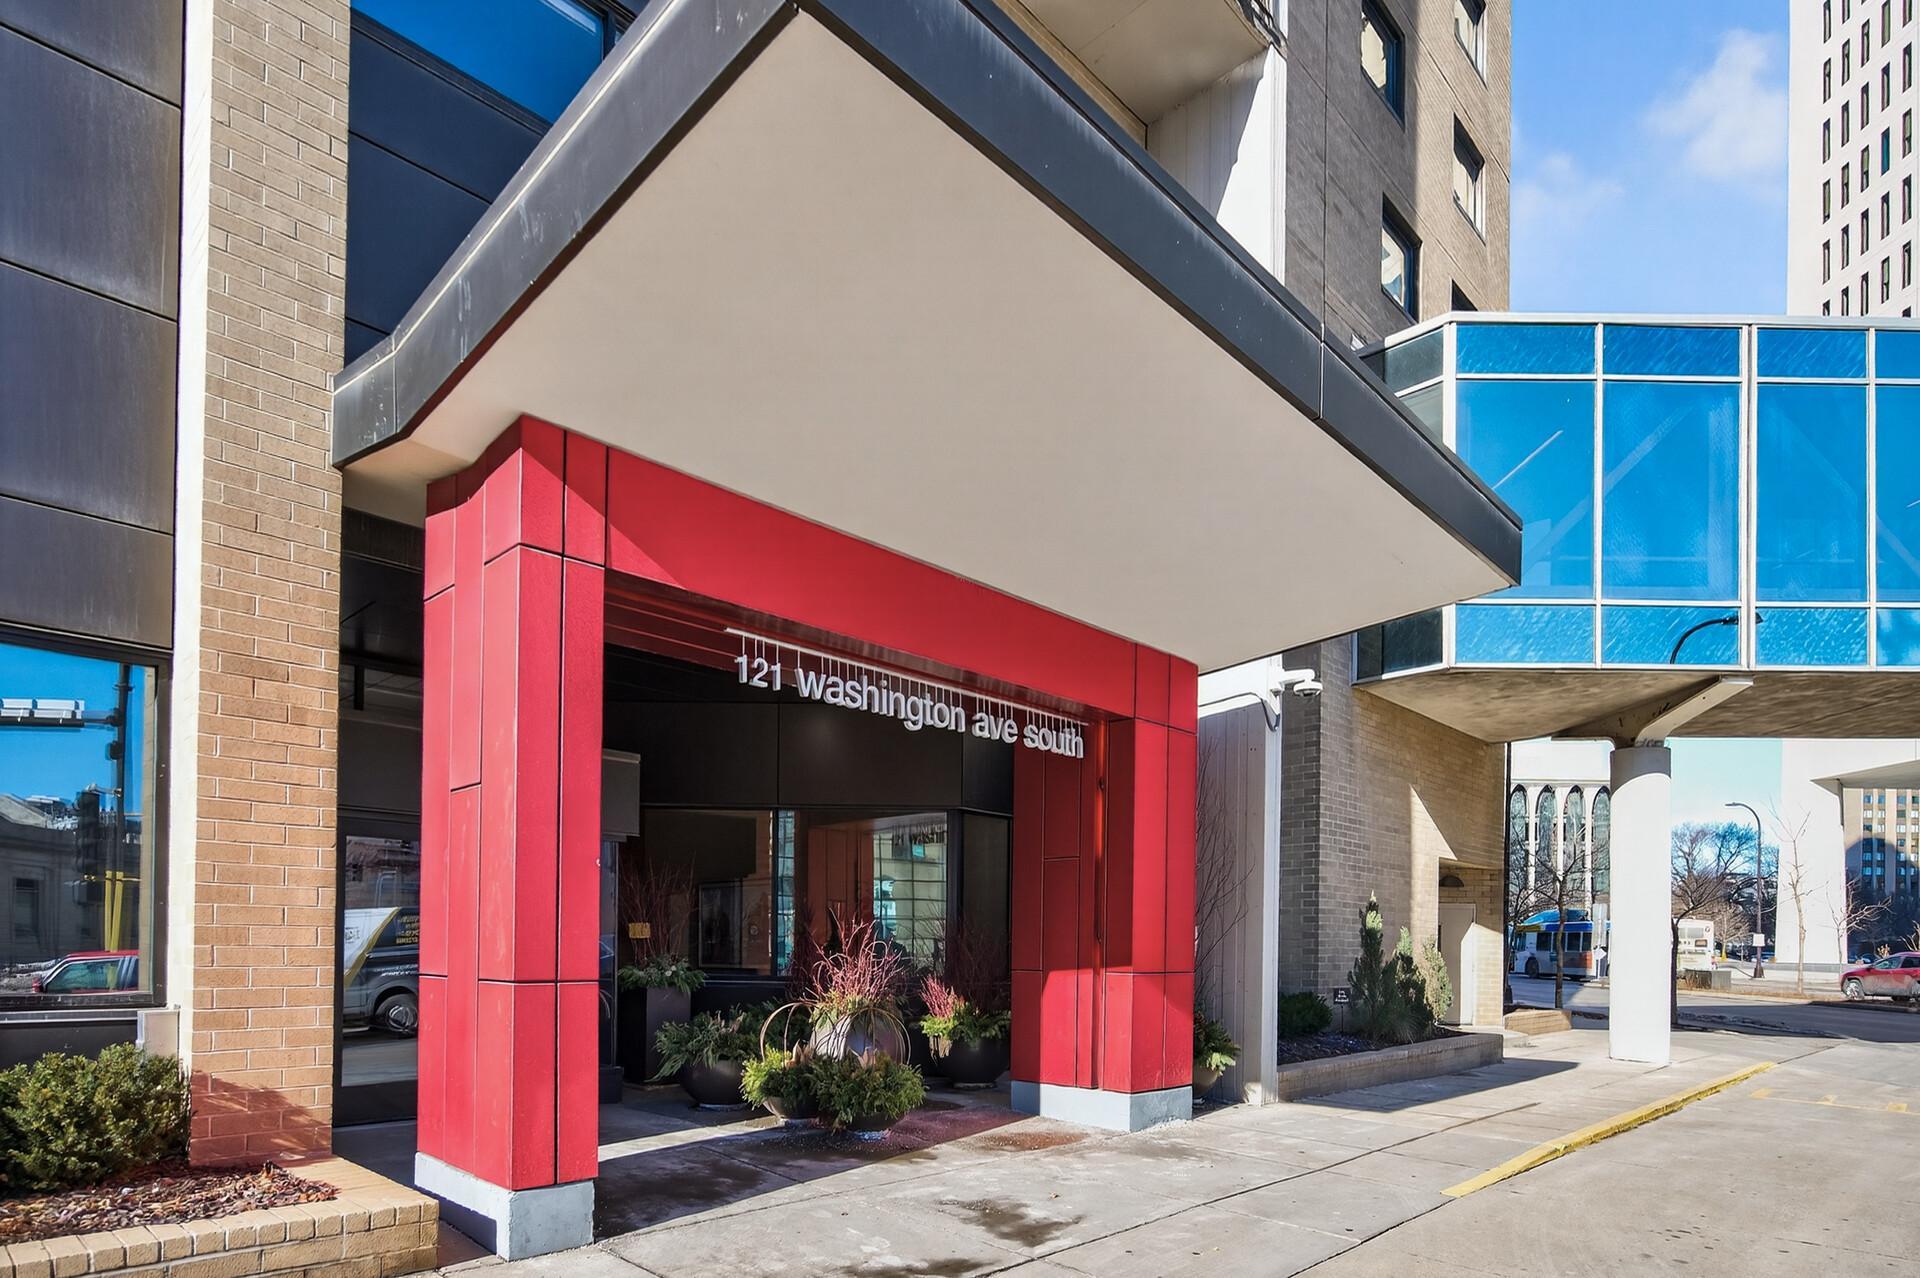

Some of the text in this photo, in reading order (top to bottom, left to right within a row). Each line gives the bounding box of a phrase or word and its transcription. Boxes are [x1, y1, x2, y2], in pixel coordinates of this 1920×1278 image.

[735, 654, 1084, 759] 121 washington ave south
